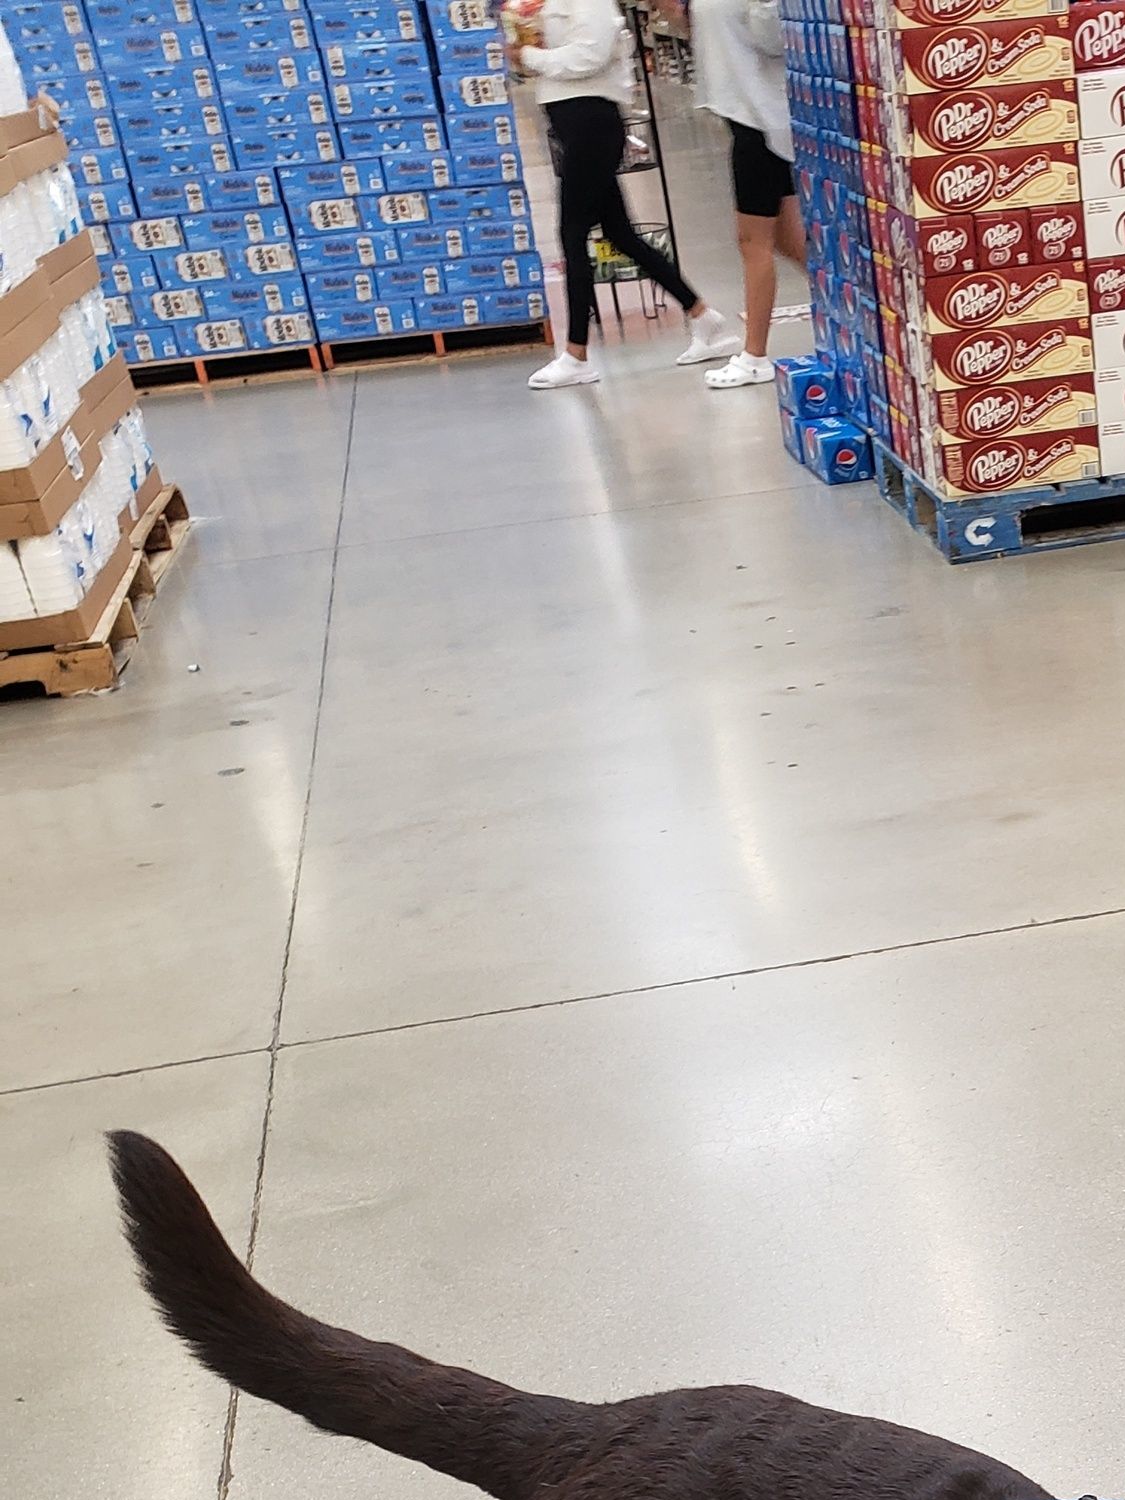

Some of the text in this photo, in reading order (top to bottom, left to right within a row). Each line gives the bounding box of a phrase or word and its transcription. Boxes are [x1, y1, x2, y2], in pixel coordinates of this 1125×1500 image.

[1099, 11, 1125, 31] Dr
[949, 38, 968, 51] Dr
[991, 38, 1004, 53] &
[1017, 33, 1042, 53] Soda
[930, 44, 981, 79] Pepper
[953, 103, 974, 117] Dr
[997, 102, 1009, 116] &
[1023, 96, 1046, 114] Soda
[934, 108, 988, 142] Pepper
[954, 165, 975, 180] Dr
[998, 165, 1011, 179] &
[1023, 158, 1047, 177] Soda
[936, 171, 988, 203] Pepper
[968, 283, 988, 298] Dr
[1010, 283, 1021, 296] &
[1035, 276, 1057, 294] Soda
[951, 289, 1000, 320] Pepper
[973, 341, 993, 355] Dr
[1015, 340, 1027, 353] &
[1042, 333, 1062, 350] Soda
[958, 346, 1006, 377] Pepper
[983, 397, 1002, 411] Dr
[1023, 396, 1034, 408] &
[1048, 389, 1068, 406] Soda
[967, 402, 1014, 431] Pepper
[988, 450, 1007, 464] Dr
[1027, 450, 1038, 461] &
[1051, 443, 1071, 458] Soda
[972, 455, 1019, 483] Pepper
